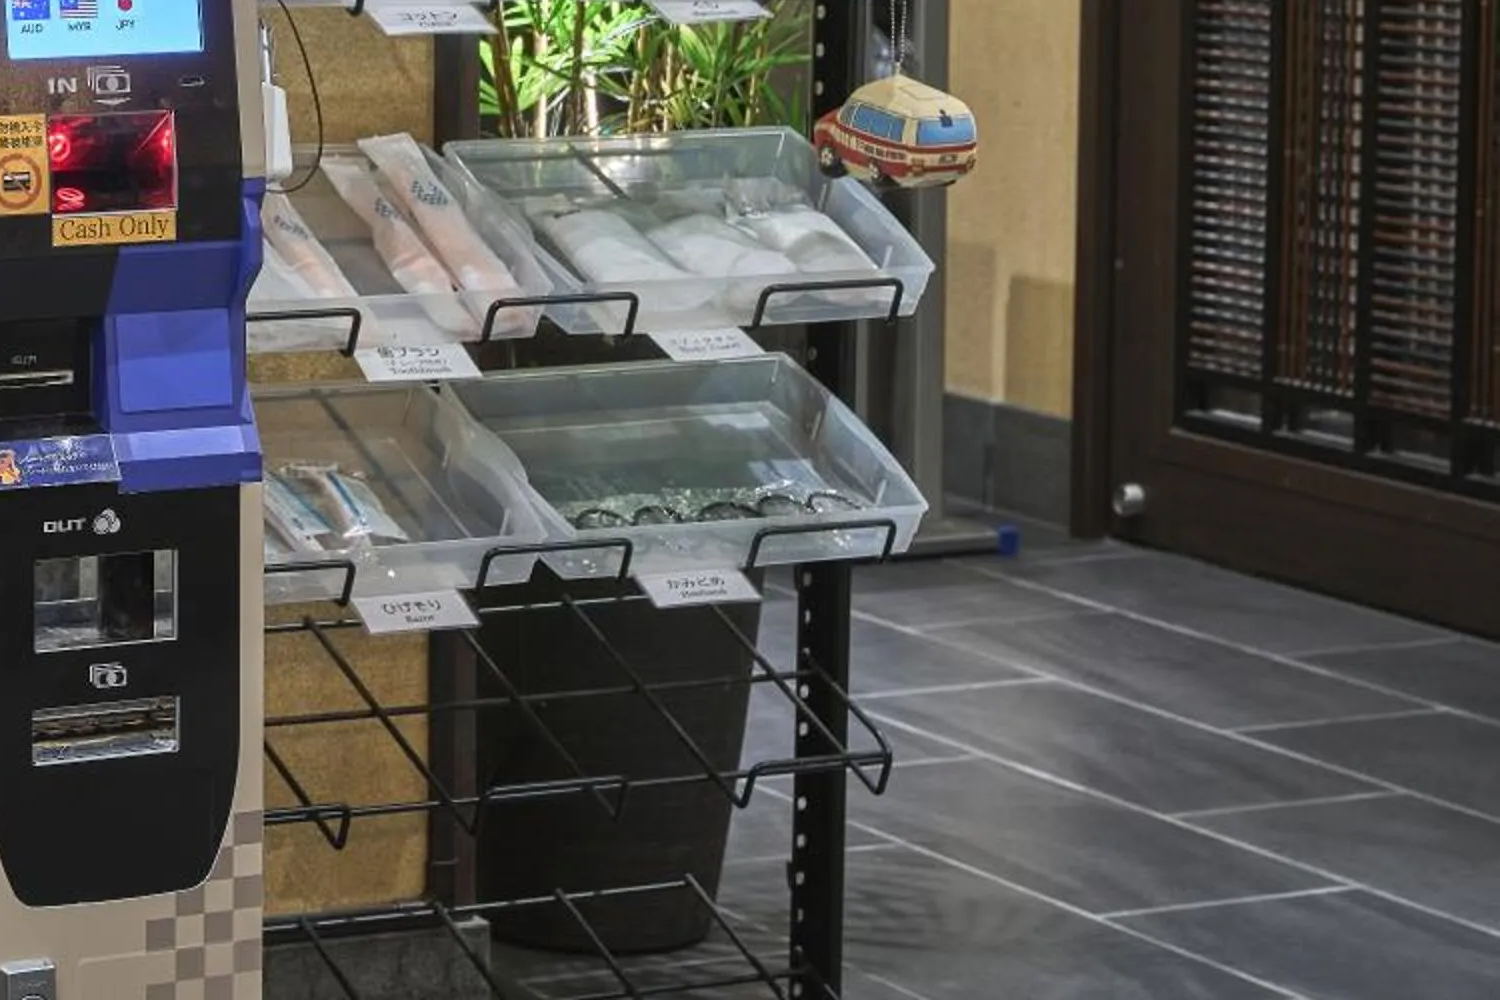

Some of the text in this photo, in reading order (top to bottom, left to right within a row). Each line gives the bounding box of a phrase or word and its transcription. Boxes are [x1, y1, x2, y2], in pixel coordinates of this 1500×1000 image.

[48, 77, 80, 95] IN
[60, 215, 172, 241] Cash Only
[43, 518, 86, 533] OUT
[382, 599, 442, 615] ひげそり
